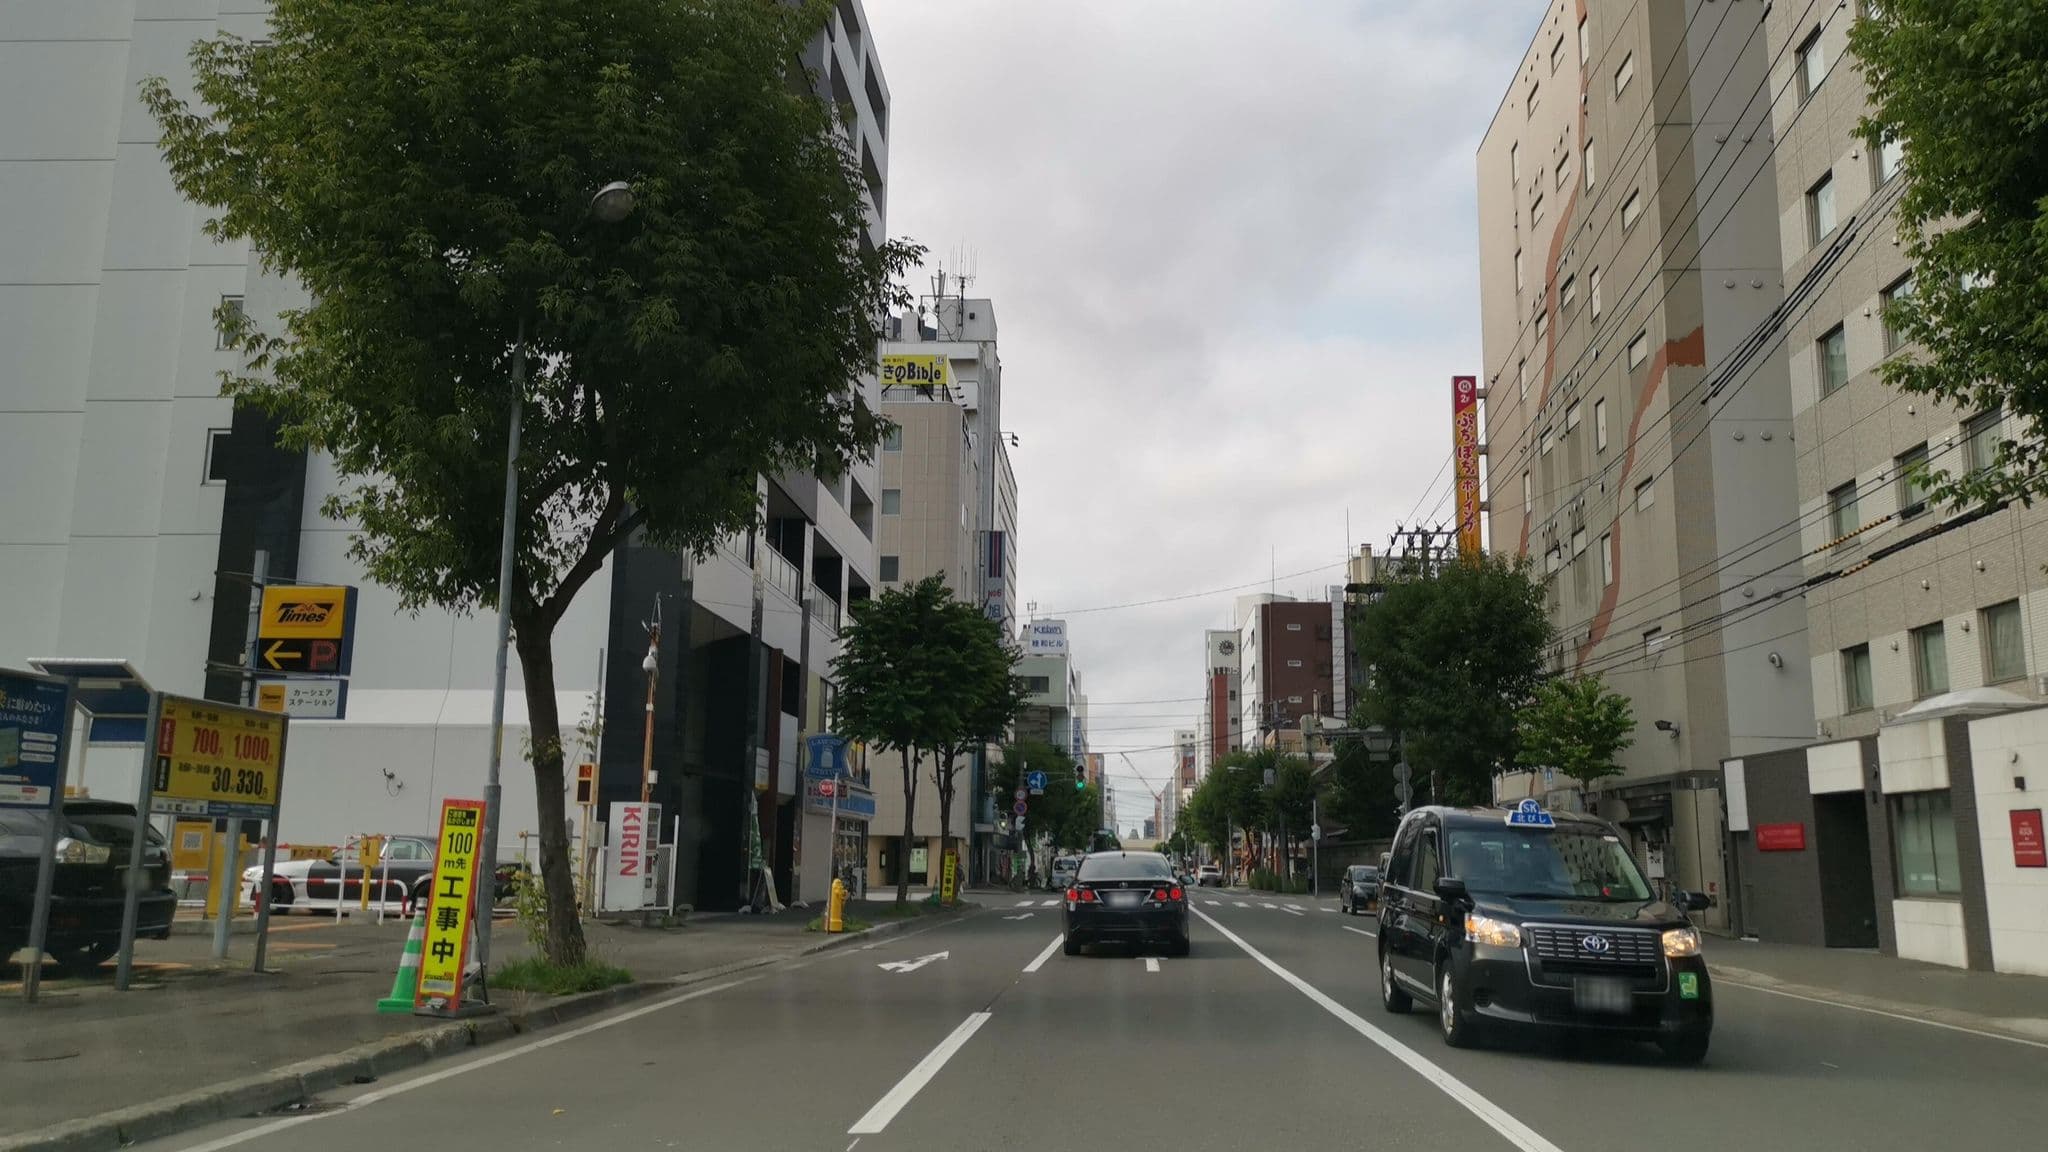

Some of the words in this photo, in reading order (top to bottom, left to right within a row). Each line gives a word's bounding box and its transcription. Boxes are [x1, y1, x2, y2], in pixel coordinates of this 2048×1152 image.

[277, 602, 335, 624] Times
[309, 639, 337, 671] P
[288, 698, 336, 707] ステーション
[293, 688, 333, 697] カーシェア
[1523, 803, 1537, 814] SK
[447, 831, 473, 855] 100
[619, 806, 642, 877] KIRIN
[443, 857, 467, 870] m先
[431, 875, 465, 964] 工事中
